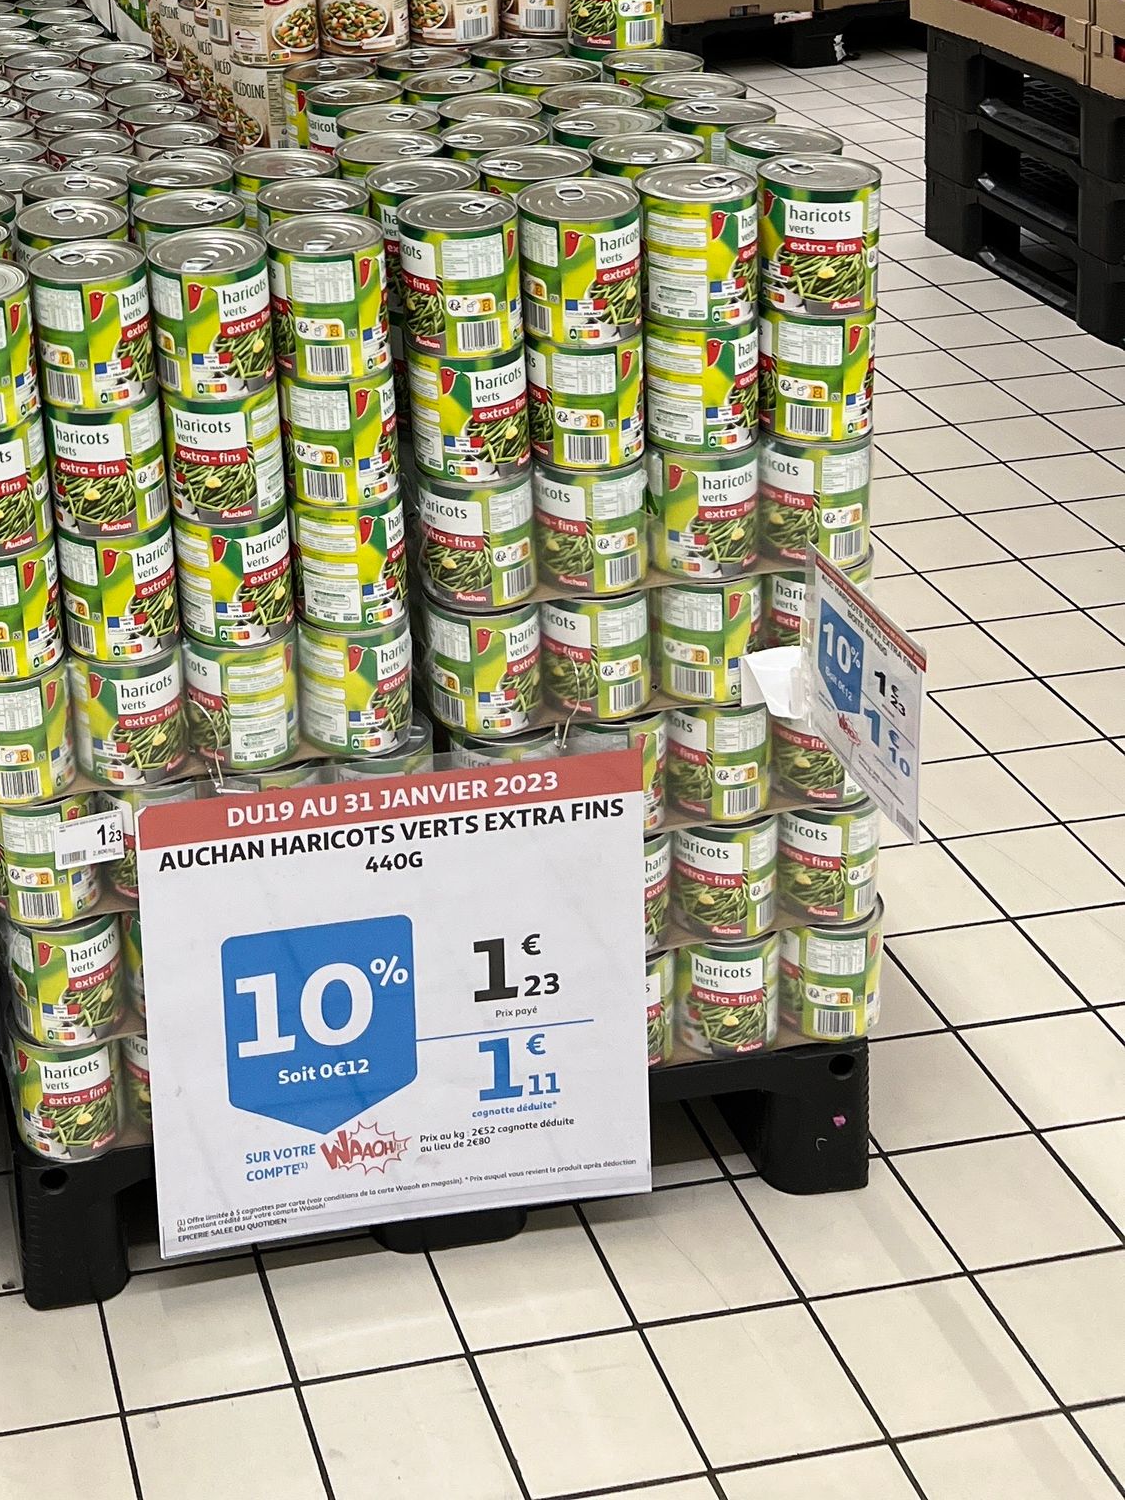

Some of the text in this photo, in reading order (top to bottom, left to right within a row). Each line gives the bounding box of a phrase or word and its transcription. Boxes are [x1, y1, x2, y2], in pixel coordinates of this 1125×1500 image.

[789, 206, 851, 224] haricots
[789, 224, 815, 236] verts
[176, 417, 232, 436] haricots
[177, 433, 198, 445] verts
[300, 798, 339, 821] AU
[344, 791, 374, 814] 31
[378, 779, 489, 812] JANVIER
[494, 771, 559, 797] 2023
[158, 798, 624, 873] AUCHAN HARICOTS VERTS EXTRA FINS
[365, 851, 424, 874] 440G
[695, 959, 752, 979] haricots
[695, 974, 719, 988] verts
[495, 1005, 538, 1019] Prix payé
[277, 1059, 370, 1085] Soit 0€12
[471, 1106, 516, 1119] cagnotte
[420, 1133, 438, 1143] Prix
[453, 1129, 465, 1141] kg
[472, 1125, 496, 1137] 2€52
[497, 1121, 539, 1135] cagnotte
[540, 1116, 575, 1129] déduite
[434, 1141, 451, 1151] lieu
[466, 1136, 491, 1148] 2€80
[245, 1144, 316, 1165] SUR VOTRE
